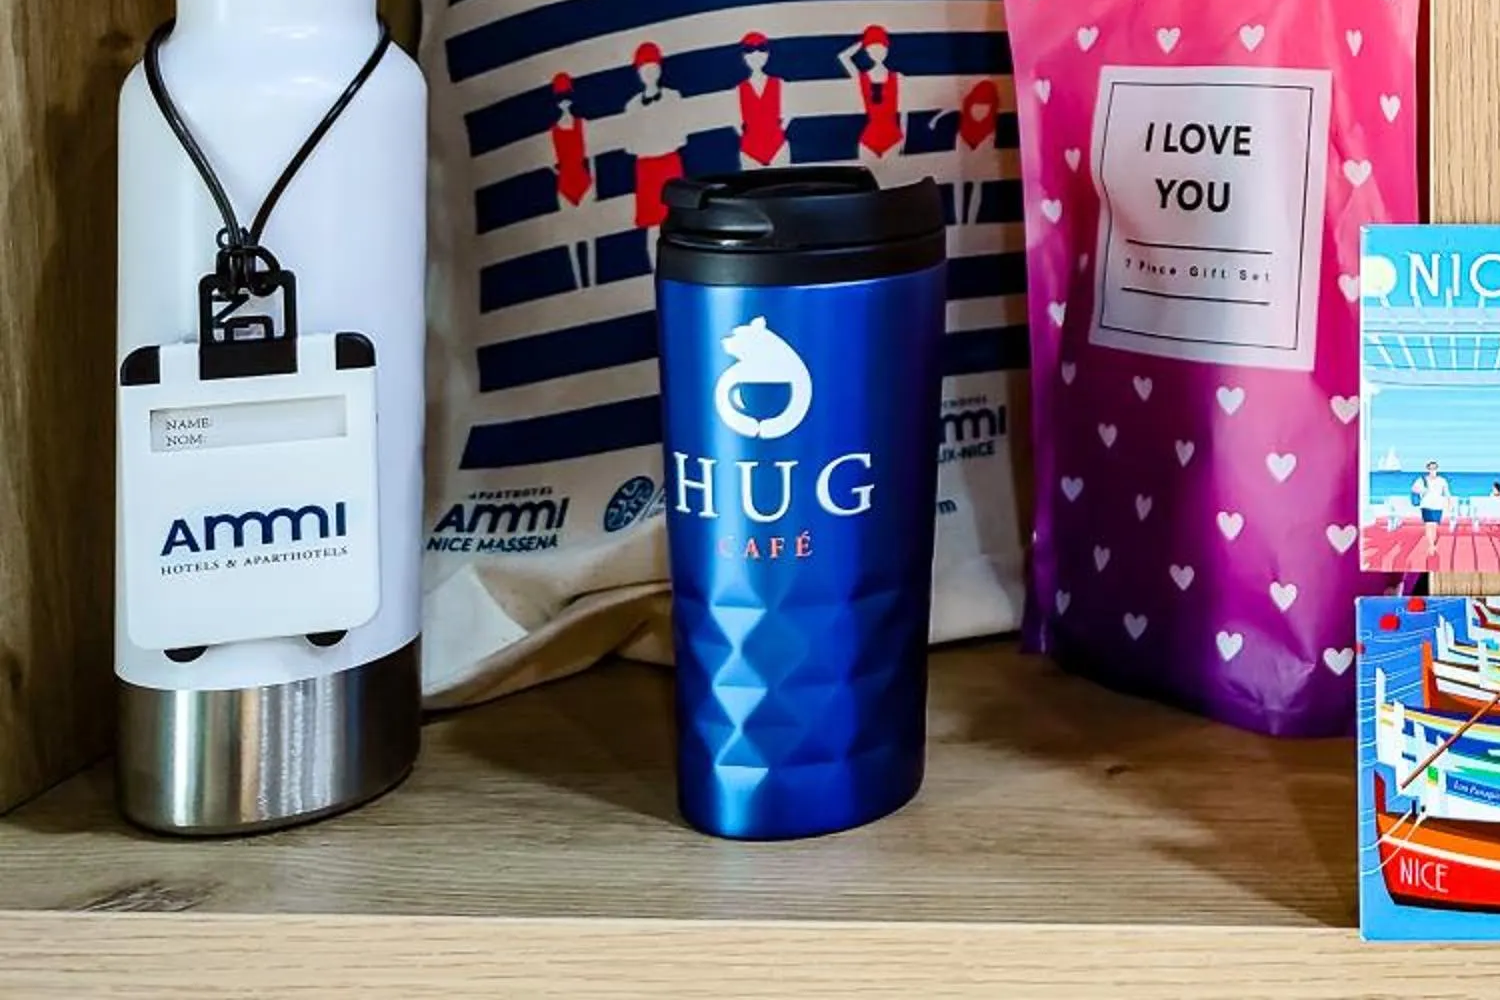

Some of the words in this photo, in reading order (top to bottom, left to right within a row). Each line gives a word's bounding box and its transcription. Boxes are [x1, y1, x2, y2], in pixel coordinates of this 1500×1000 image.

[1145, 122, 1155, 152] I
[1163, 122, 1252, 156] LOVE
[1155, 178, 1230, 213] YOU
[1189, 265, 1227, 280] Gift
[1239, 269, 1271, 283] Set
[426, 537, 474, 552] NICE
[477, 534, 559, 553] MASSENA
[718, 531, 813, 559] CAFÉ
[160, 561, 220, 577] HOTELS
[225, 559, 238, 569] &
[243, 546, 349, 567] APARTHOTELS
[1400, 855, 1449, 893] NICE
